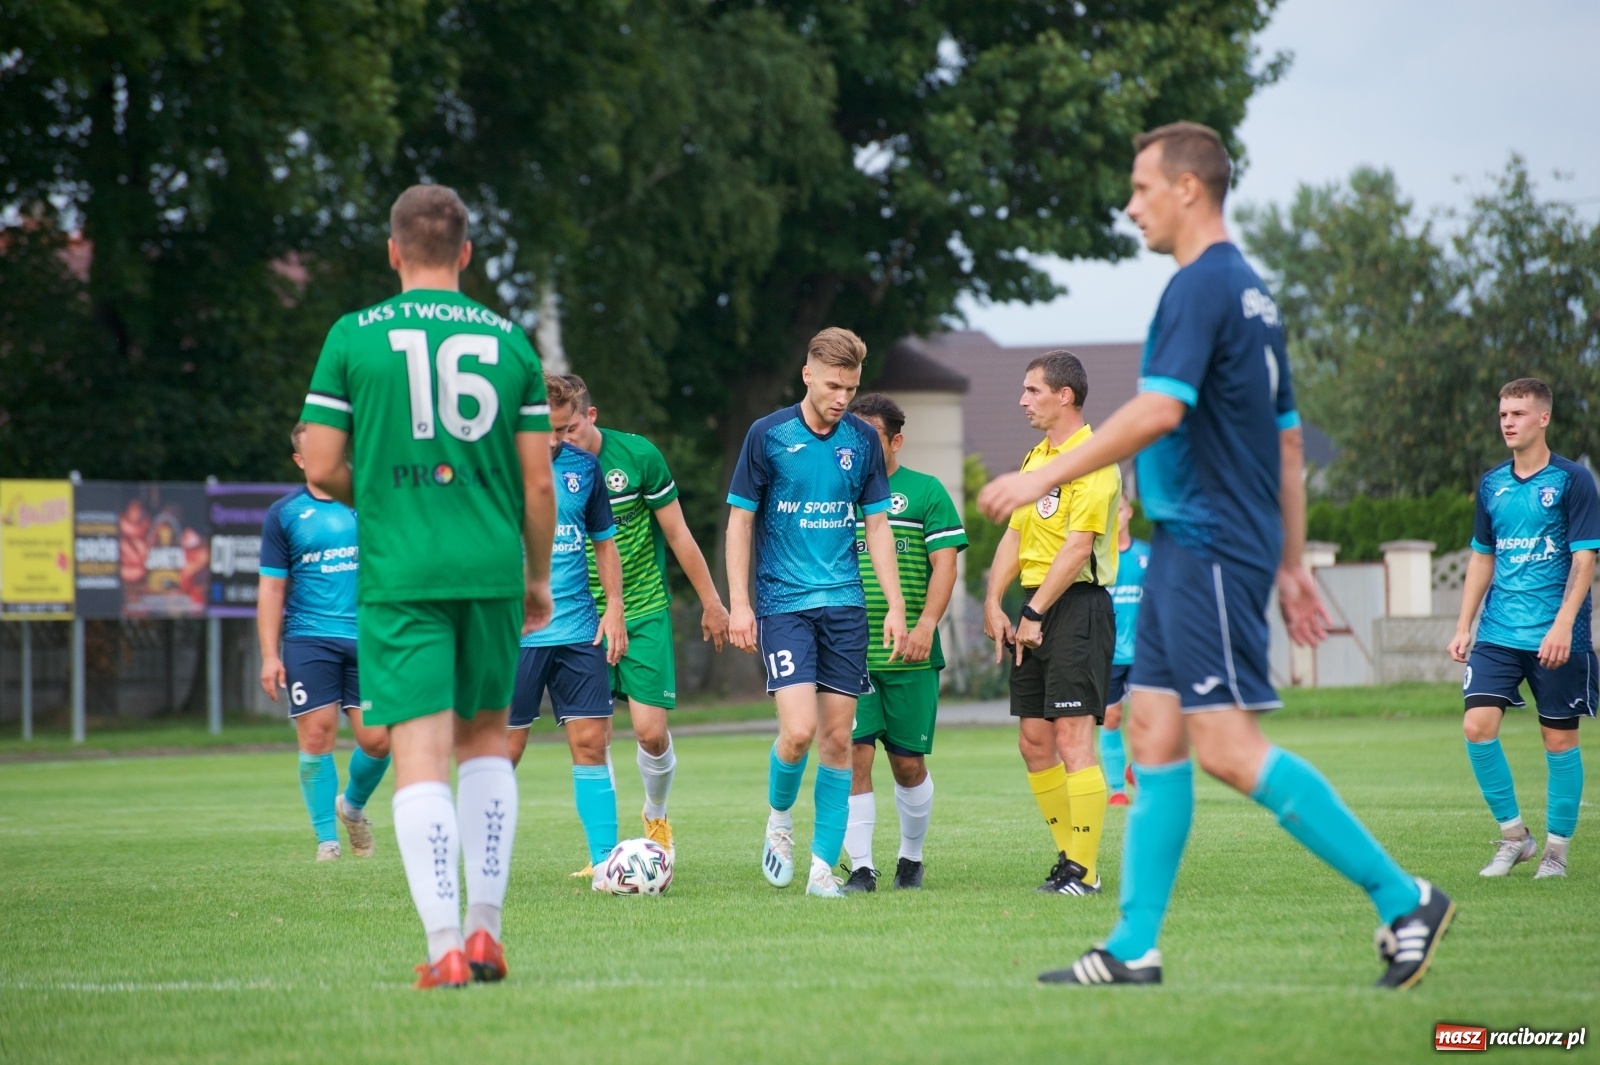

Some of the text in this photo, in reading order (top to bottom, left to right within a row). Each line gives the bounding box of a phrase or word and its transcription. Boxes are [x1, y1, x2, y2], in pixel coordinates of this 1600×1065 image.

[358, 304, 395, 327] LKS
[387, 328, 499, 442] 16
[777, 500, 845, 514] MW SPORT
[768, 650, 795, 679] 13
[290, 681, 308, 706] 6
